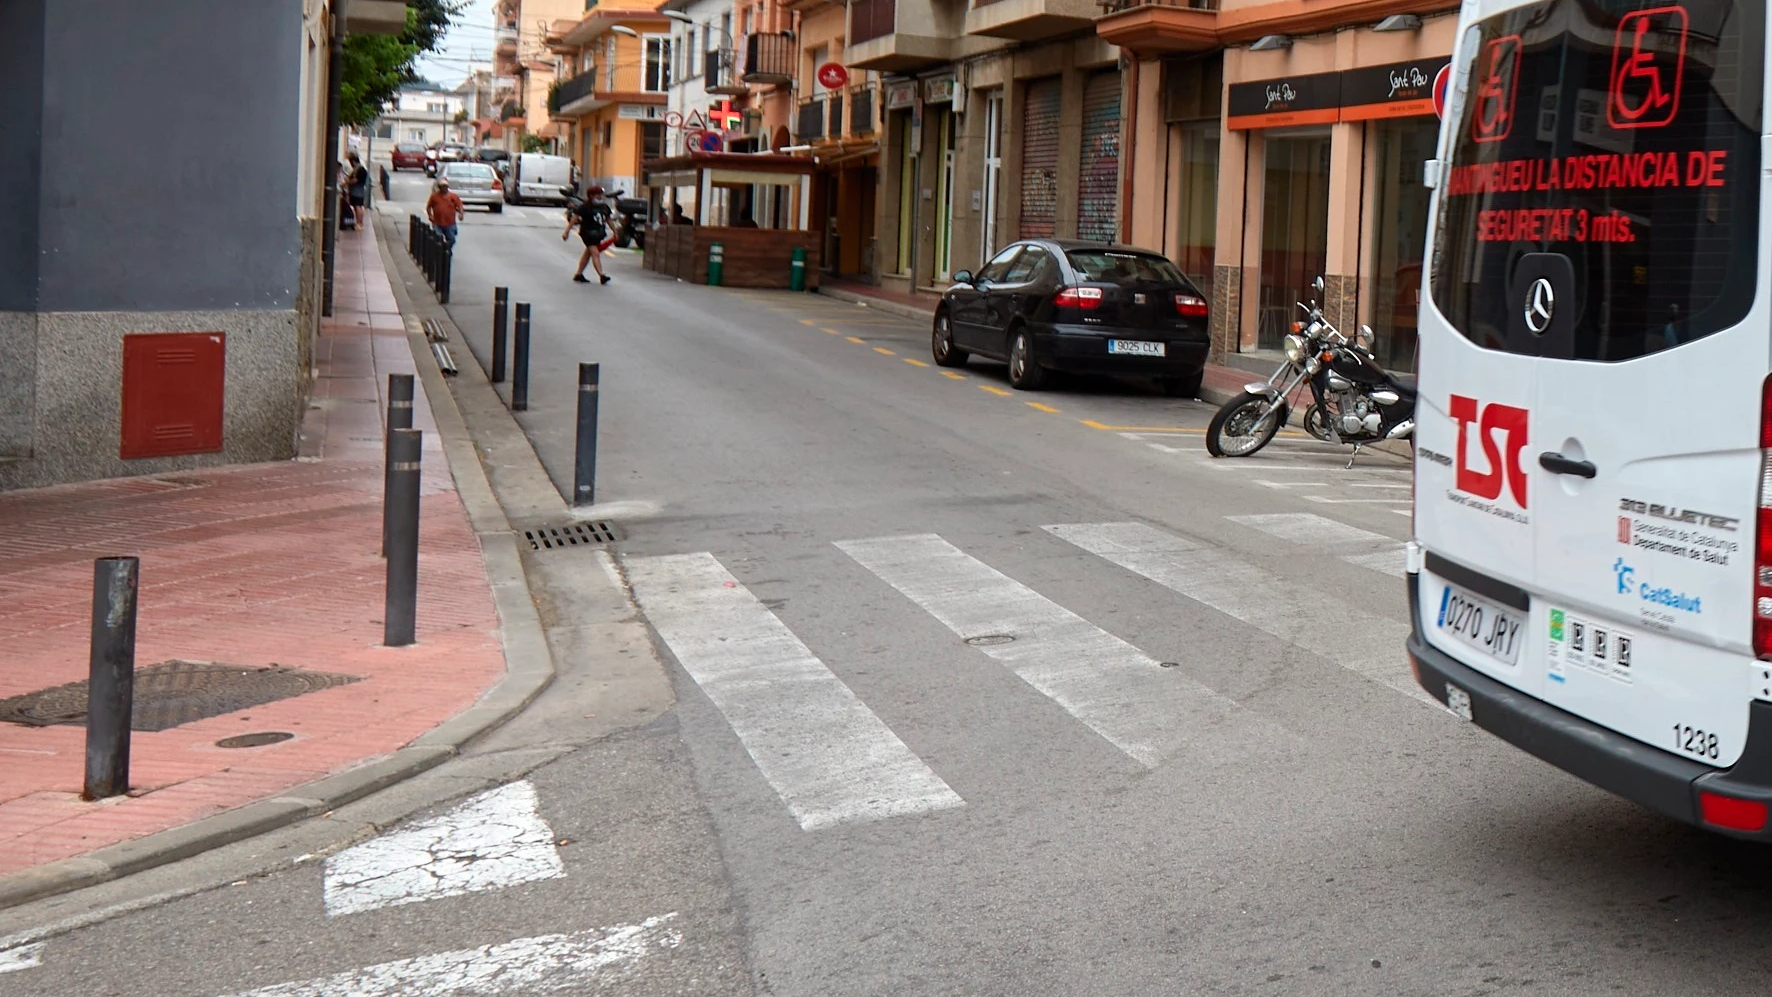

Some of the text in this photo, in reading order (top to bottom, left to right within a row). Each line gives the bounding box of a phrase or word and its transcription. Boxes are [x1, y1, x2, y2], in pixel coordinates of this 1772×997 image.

[1264, 83, 1296, 109] Sant Pau
[1388, 66, 1428, 98] Sant Pau
[1536, 157, 1560, 190] LA
[1563, 152, 1681, 189] DISTANCIA
[1686, 150, 1727, 186] DE
[1477, 208, 1635, 243] SEGURETAT 3 mts.
[1117, 340, 1159, 353] 9025 CLK
[1449, 394, 1529, 510] TSC
[1640, 583, 1701, 614] CatSalut
[1447, 595, 1519, 655] 0270 JRY
[1673, 723, 1719, 760] 1238
